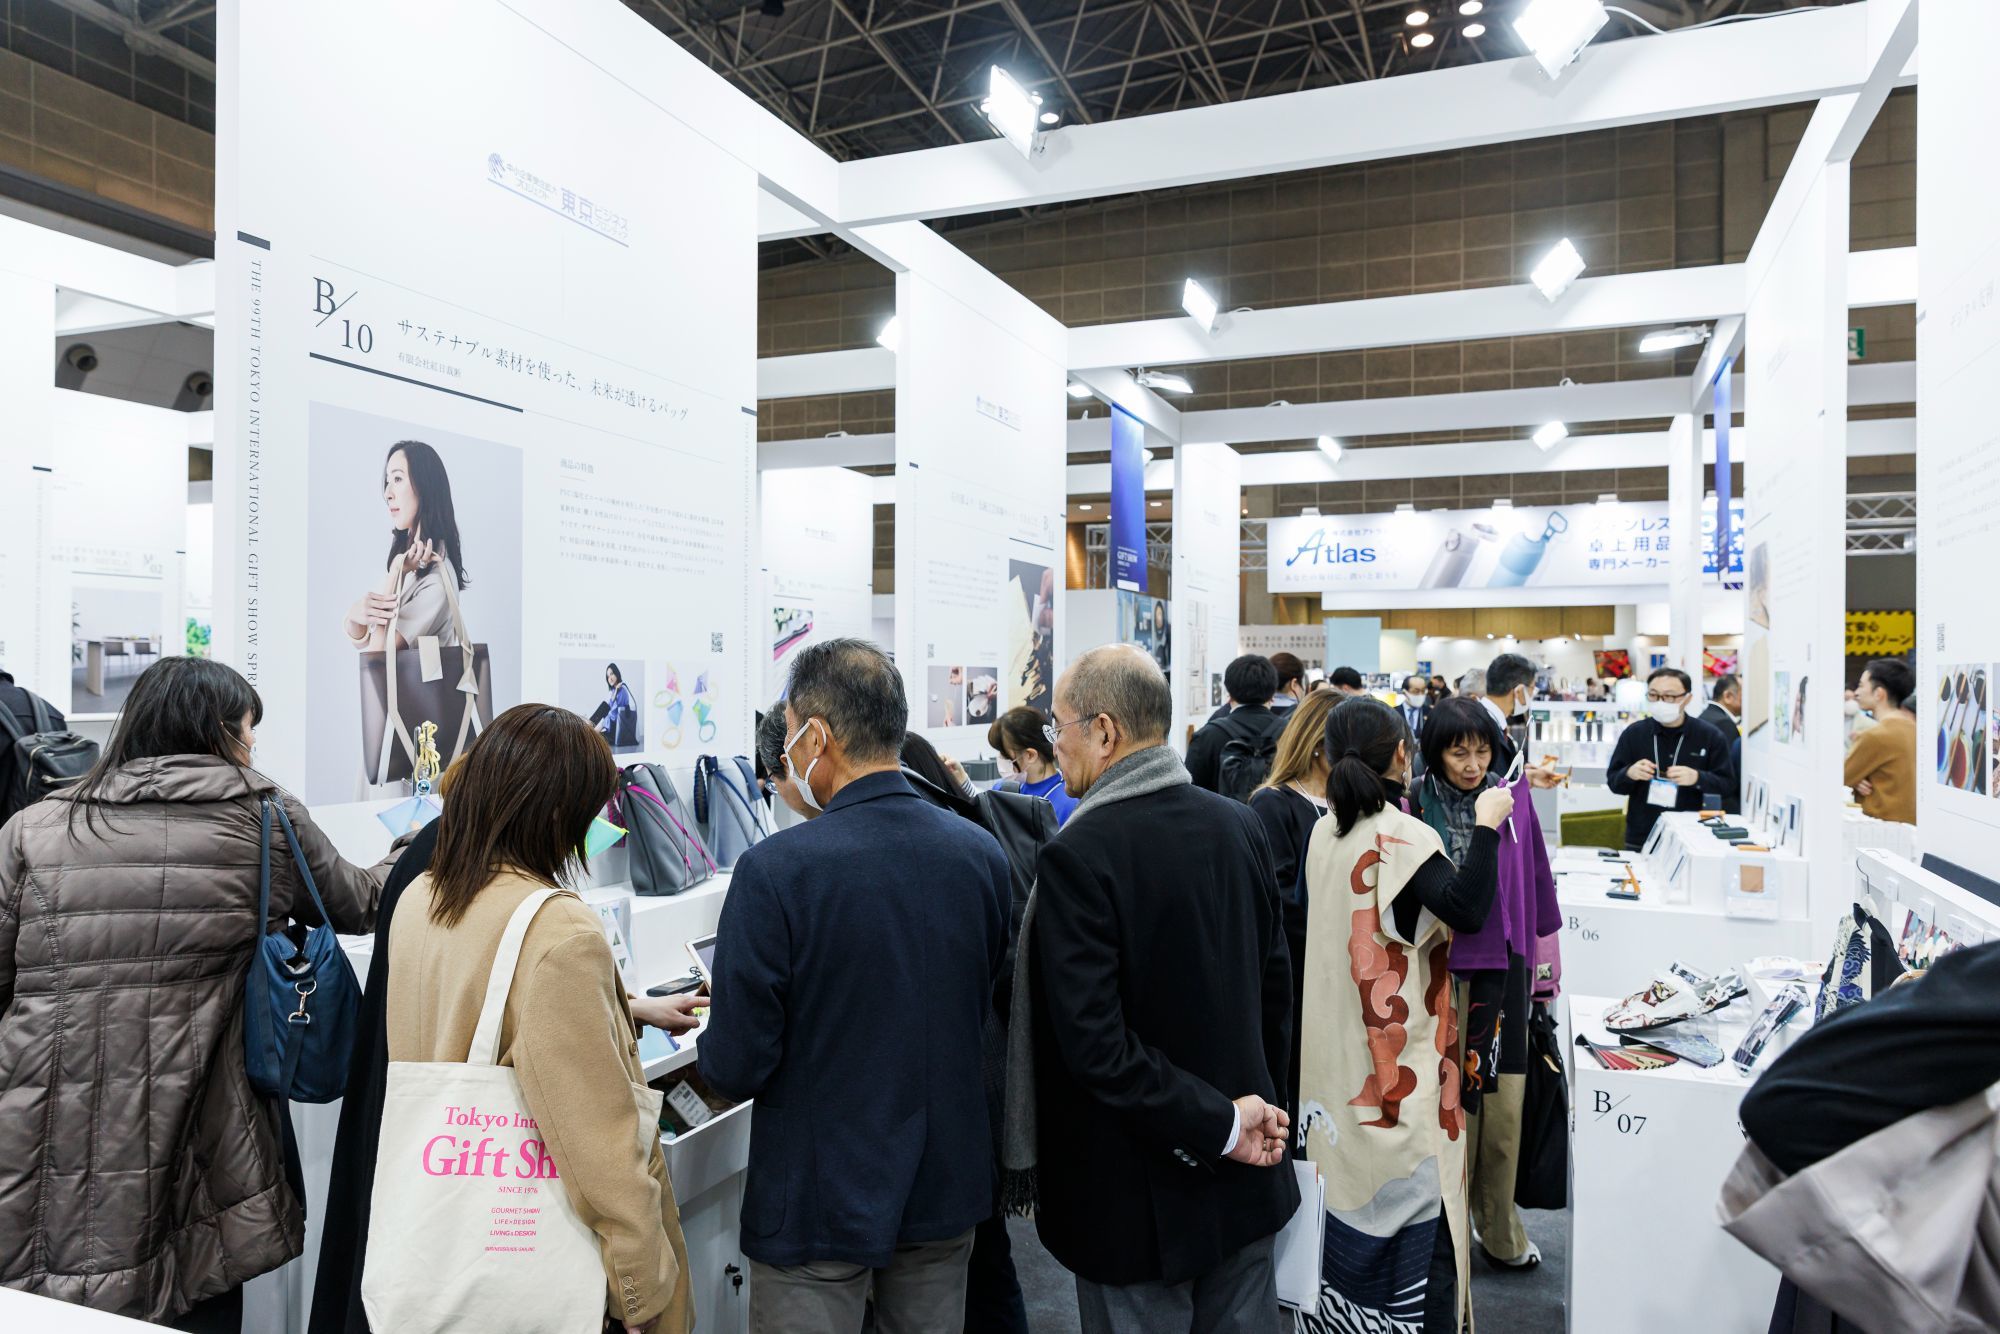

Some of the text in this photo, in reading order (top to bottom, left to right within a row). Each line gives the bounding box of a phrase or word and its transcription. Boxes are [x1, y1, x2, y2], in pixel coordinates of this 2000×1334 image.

[561, 187, 594, 225] 東京
[250, 260, 262, 293] THE
[250, 298, 262, 339] 99TH
[249, 346, 261, 403] TOKYO
[248, 409, 260, 547] INTERNATIONAL
[1286, 527, 1377, 567] Atlas
[1589, 536, 1670, 552] 卓上用品
[248, 553, 259, 592] GIFT
[247, 598, 258, 646] SHOW
[445, 1106, 509, 1132] Tokyo
[422, 1135, 510, 1178] Gift
[497, 1186, 523, 1194] SINCE
[491, 1207, 541, 1215] GOURMET SHOW
